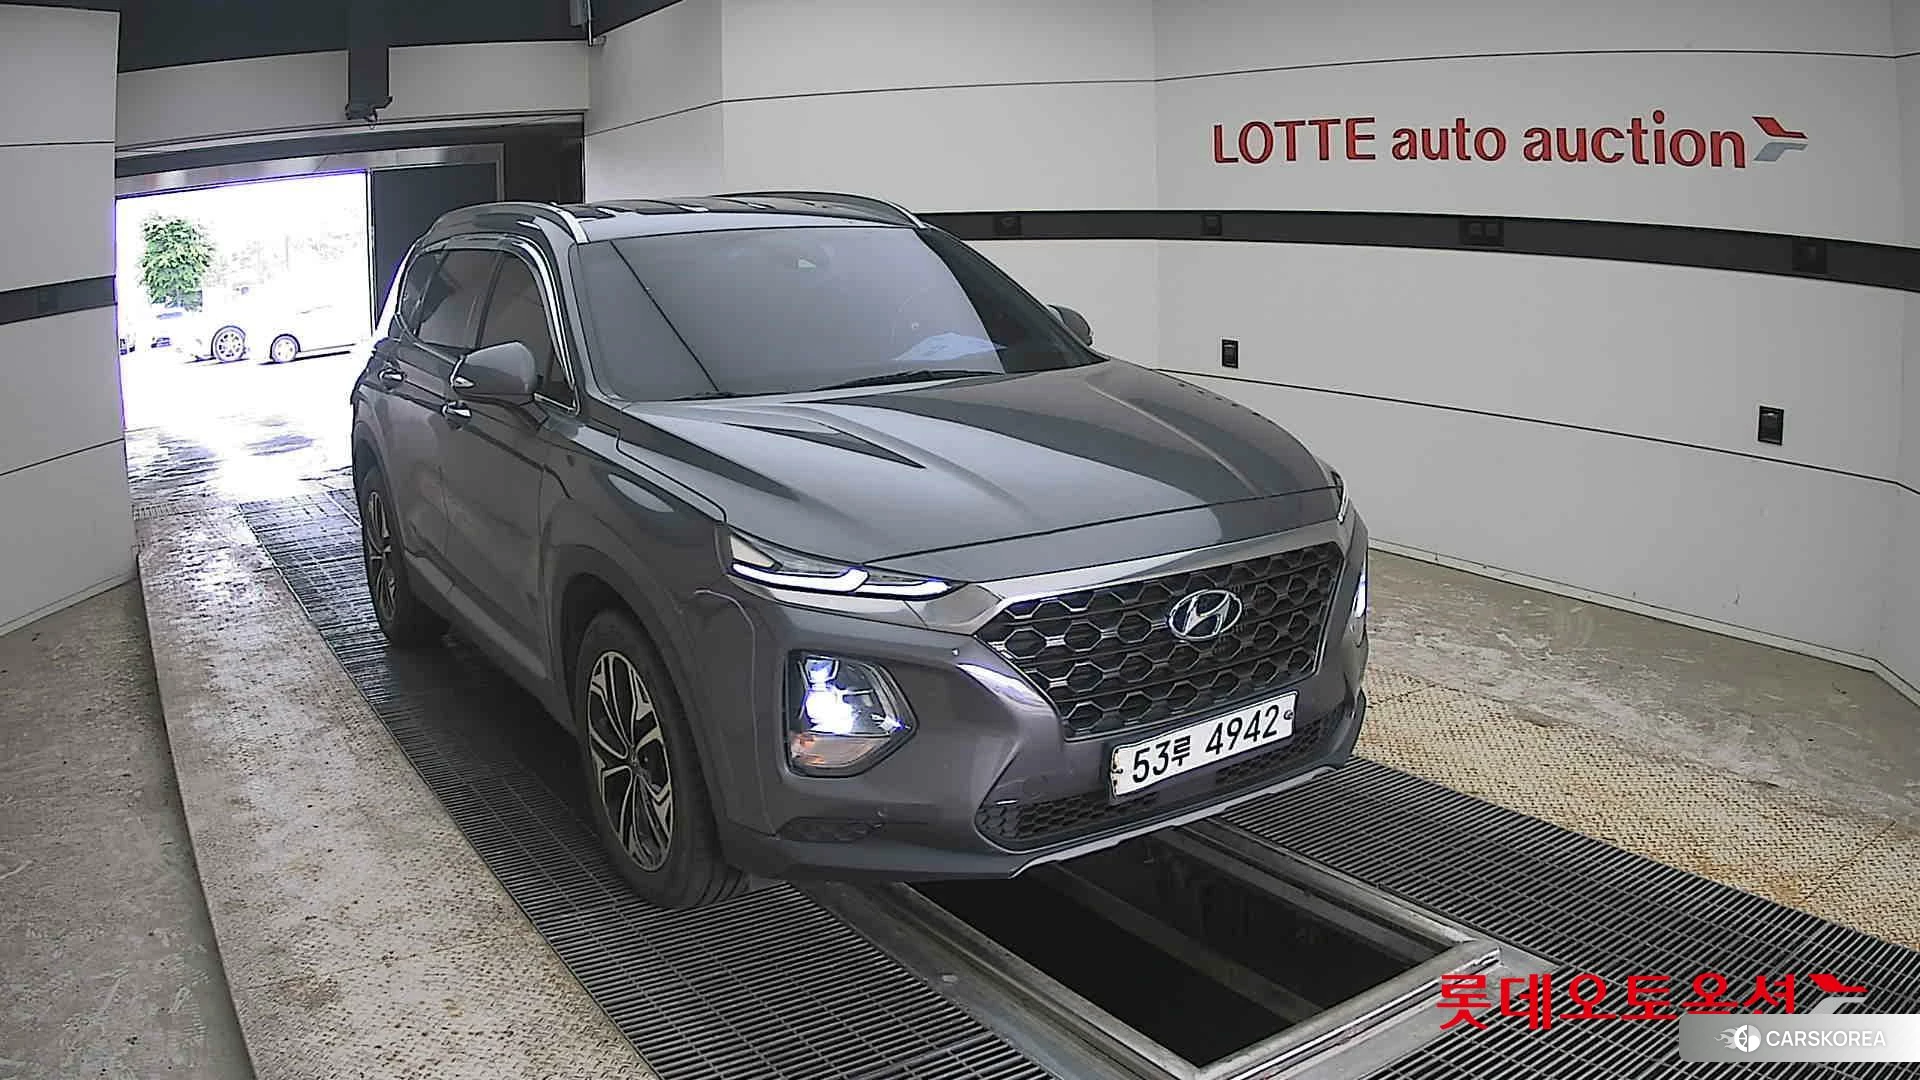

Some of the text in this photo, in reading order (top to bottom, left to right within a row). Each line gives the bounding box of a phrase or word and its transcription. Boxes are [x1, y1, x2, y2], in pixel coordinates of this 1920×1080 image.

[1212, 109, 1746, 169] LOTTE auto auction
[1132, 705, 1279, 784] 53루 4942
